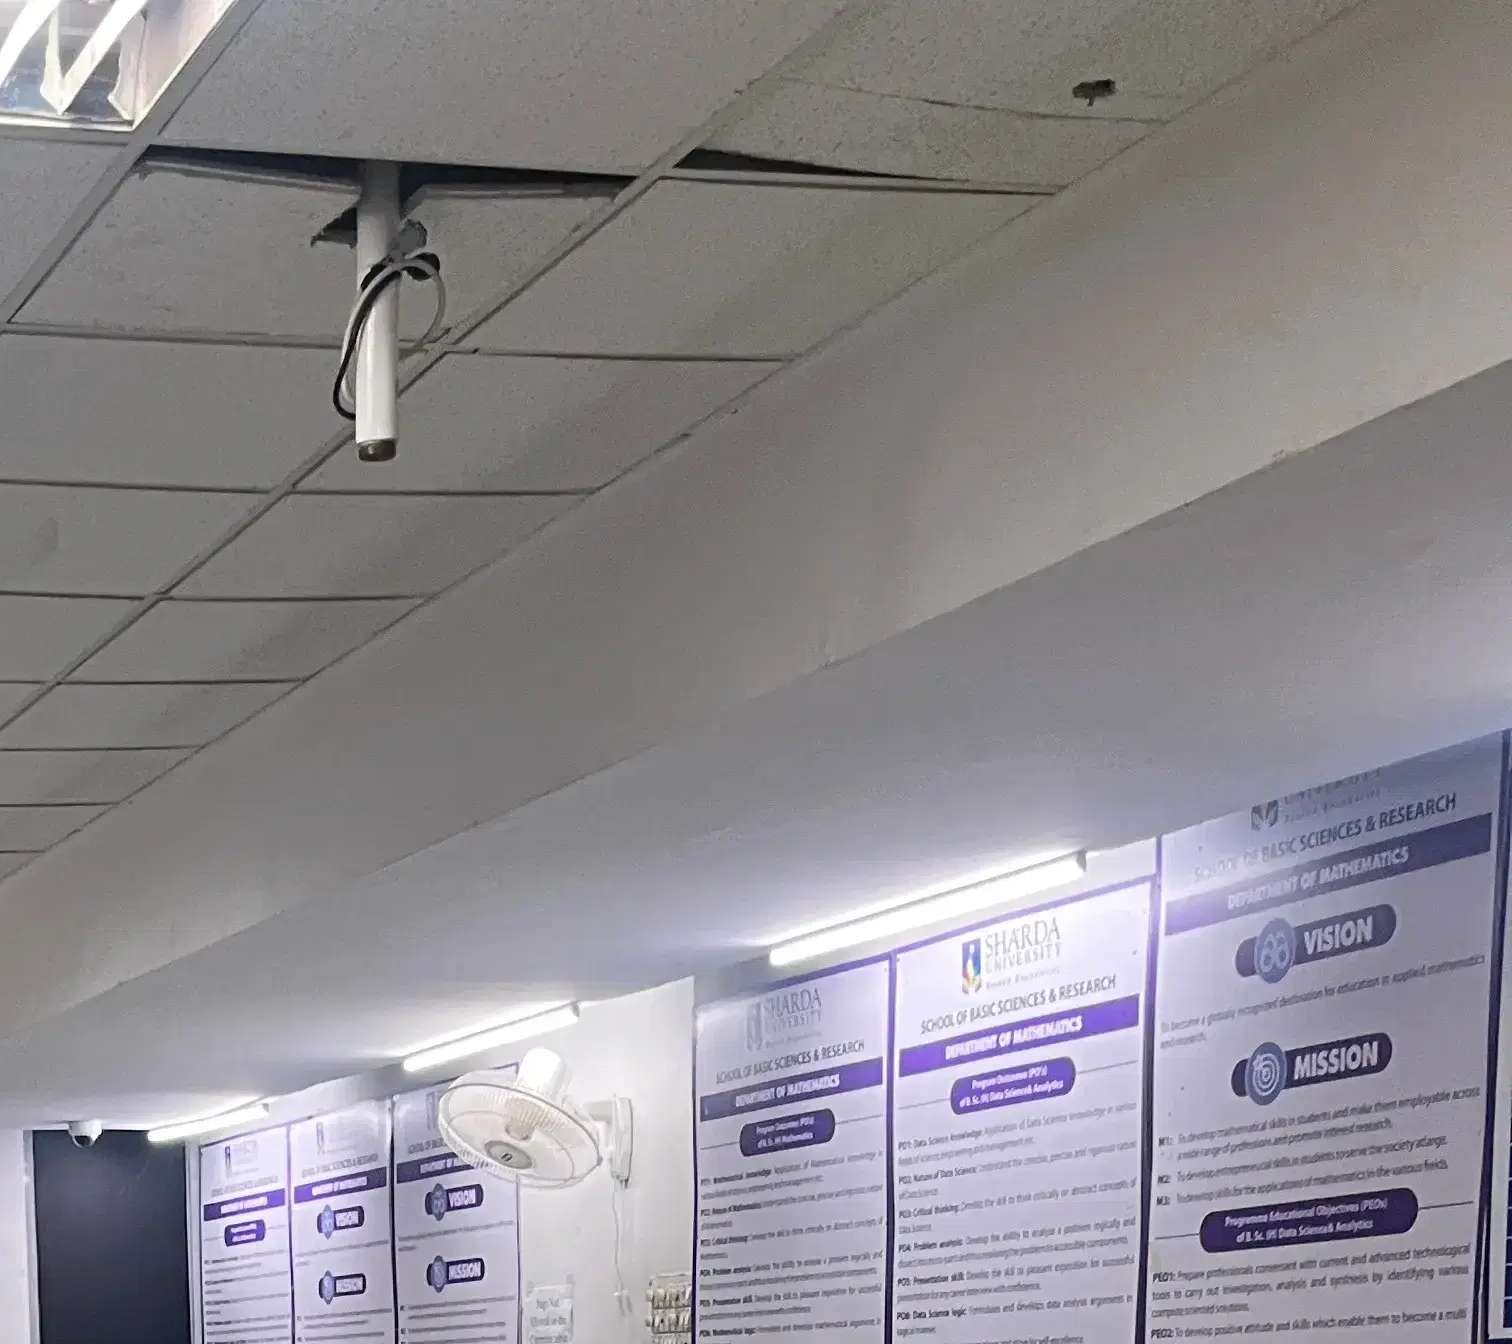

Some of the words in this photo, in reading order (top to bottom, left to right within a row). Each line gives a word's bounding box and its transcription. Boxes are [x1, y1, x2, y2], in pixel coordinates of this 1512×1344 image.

[1299, 818, 1361, 851] SCIENCES
[1379, 792, 1456, 830] RESEARCH
[1228, 876, 1299, 909] DEPARTMENT
[1319, 846, 1410, 884] MATHEMATICS
[985, 917, 1061, 957] SHARDA
[1304, 916, 1373, 955] VISION
[985, 942, 1061, 974] UNIVERSITY
[921, 1017, 955, 1034] SCHOOL
[970, 1002, 997, 1022] BASIC
[998, 990, 1046, 1016] SCIENCES
[1059, 974, 1116, 1001] RESEARCH
[1013, 1015, 1083, 1044] MATHEMATICS
[775, 1050, 811, 1071] SCIENCES
[822, 1040, 864, 1059] RESEARCH
[1294, 1040, 1379, 1080] MISSION
[1151, 1328, 1175, 1339] PEO2:
